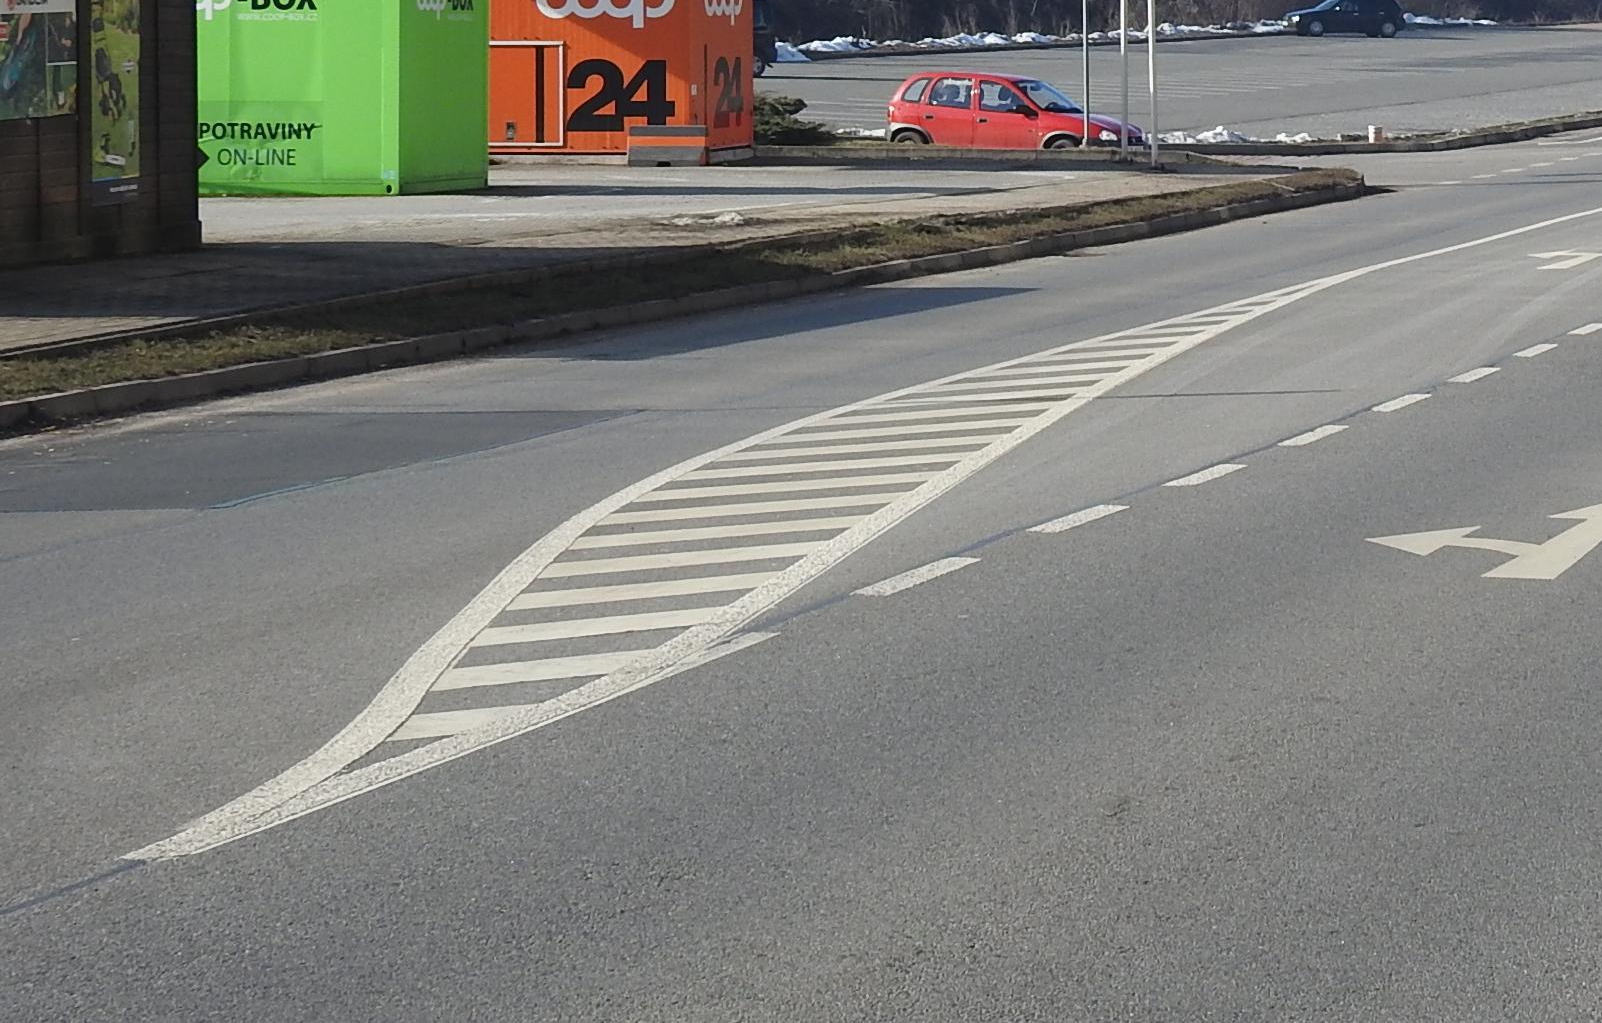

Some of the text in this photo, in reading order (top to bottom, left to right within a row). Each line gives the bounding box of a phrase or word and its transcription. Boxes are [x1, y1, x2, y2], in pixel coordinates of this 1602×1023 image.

[566, 58, 675, 132] 24
[713, 56, 744, 129] 24
[199, 123, 317, 139] POTRAVINY
[217, 148, 296, 166] ON-LINE
